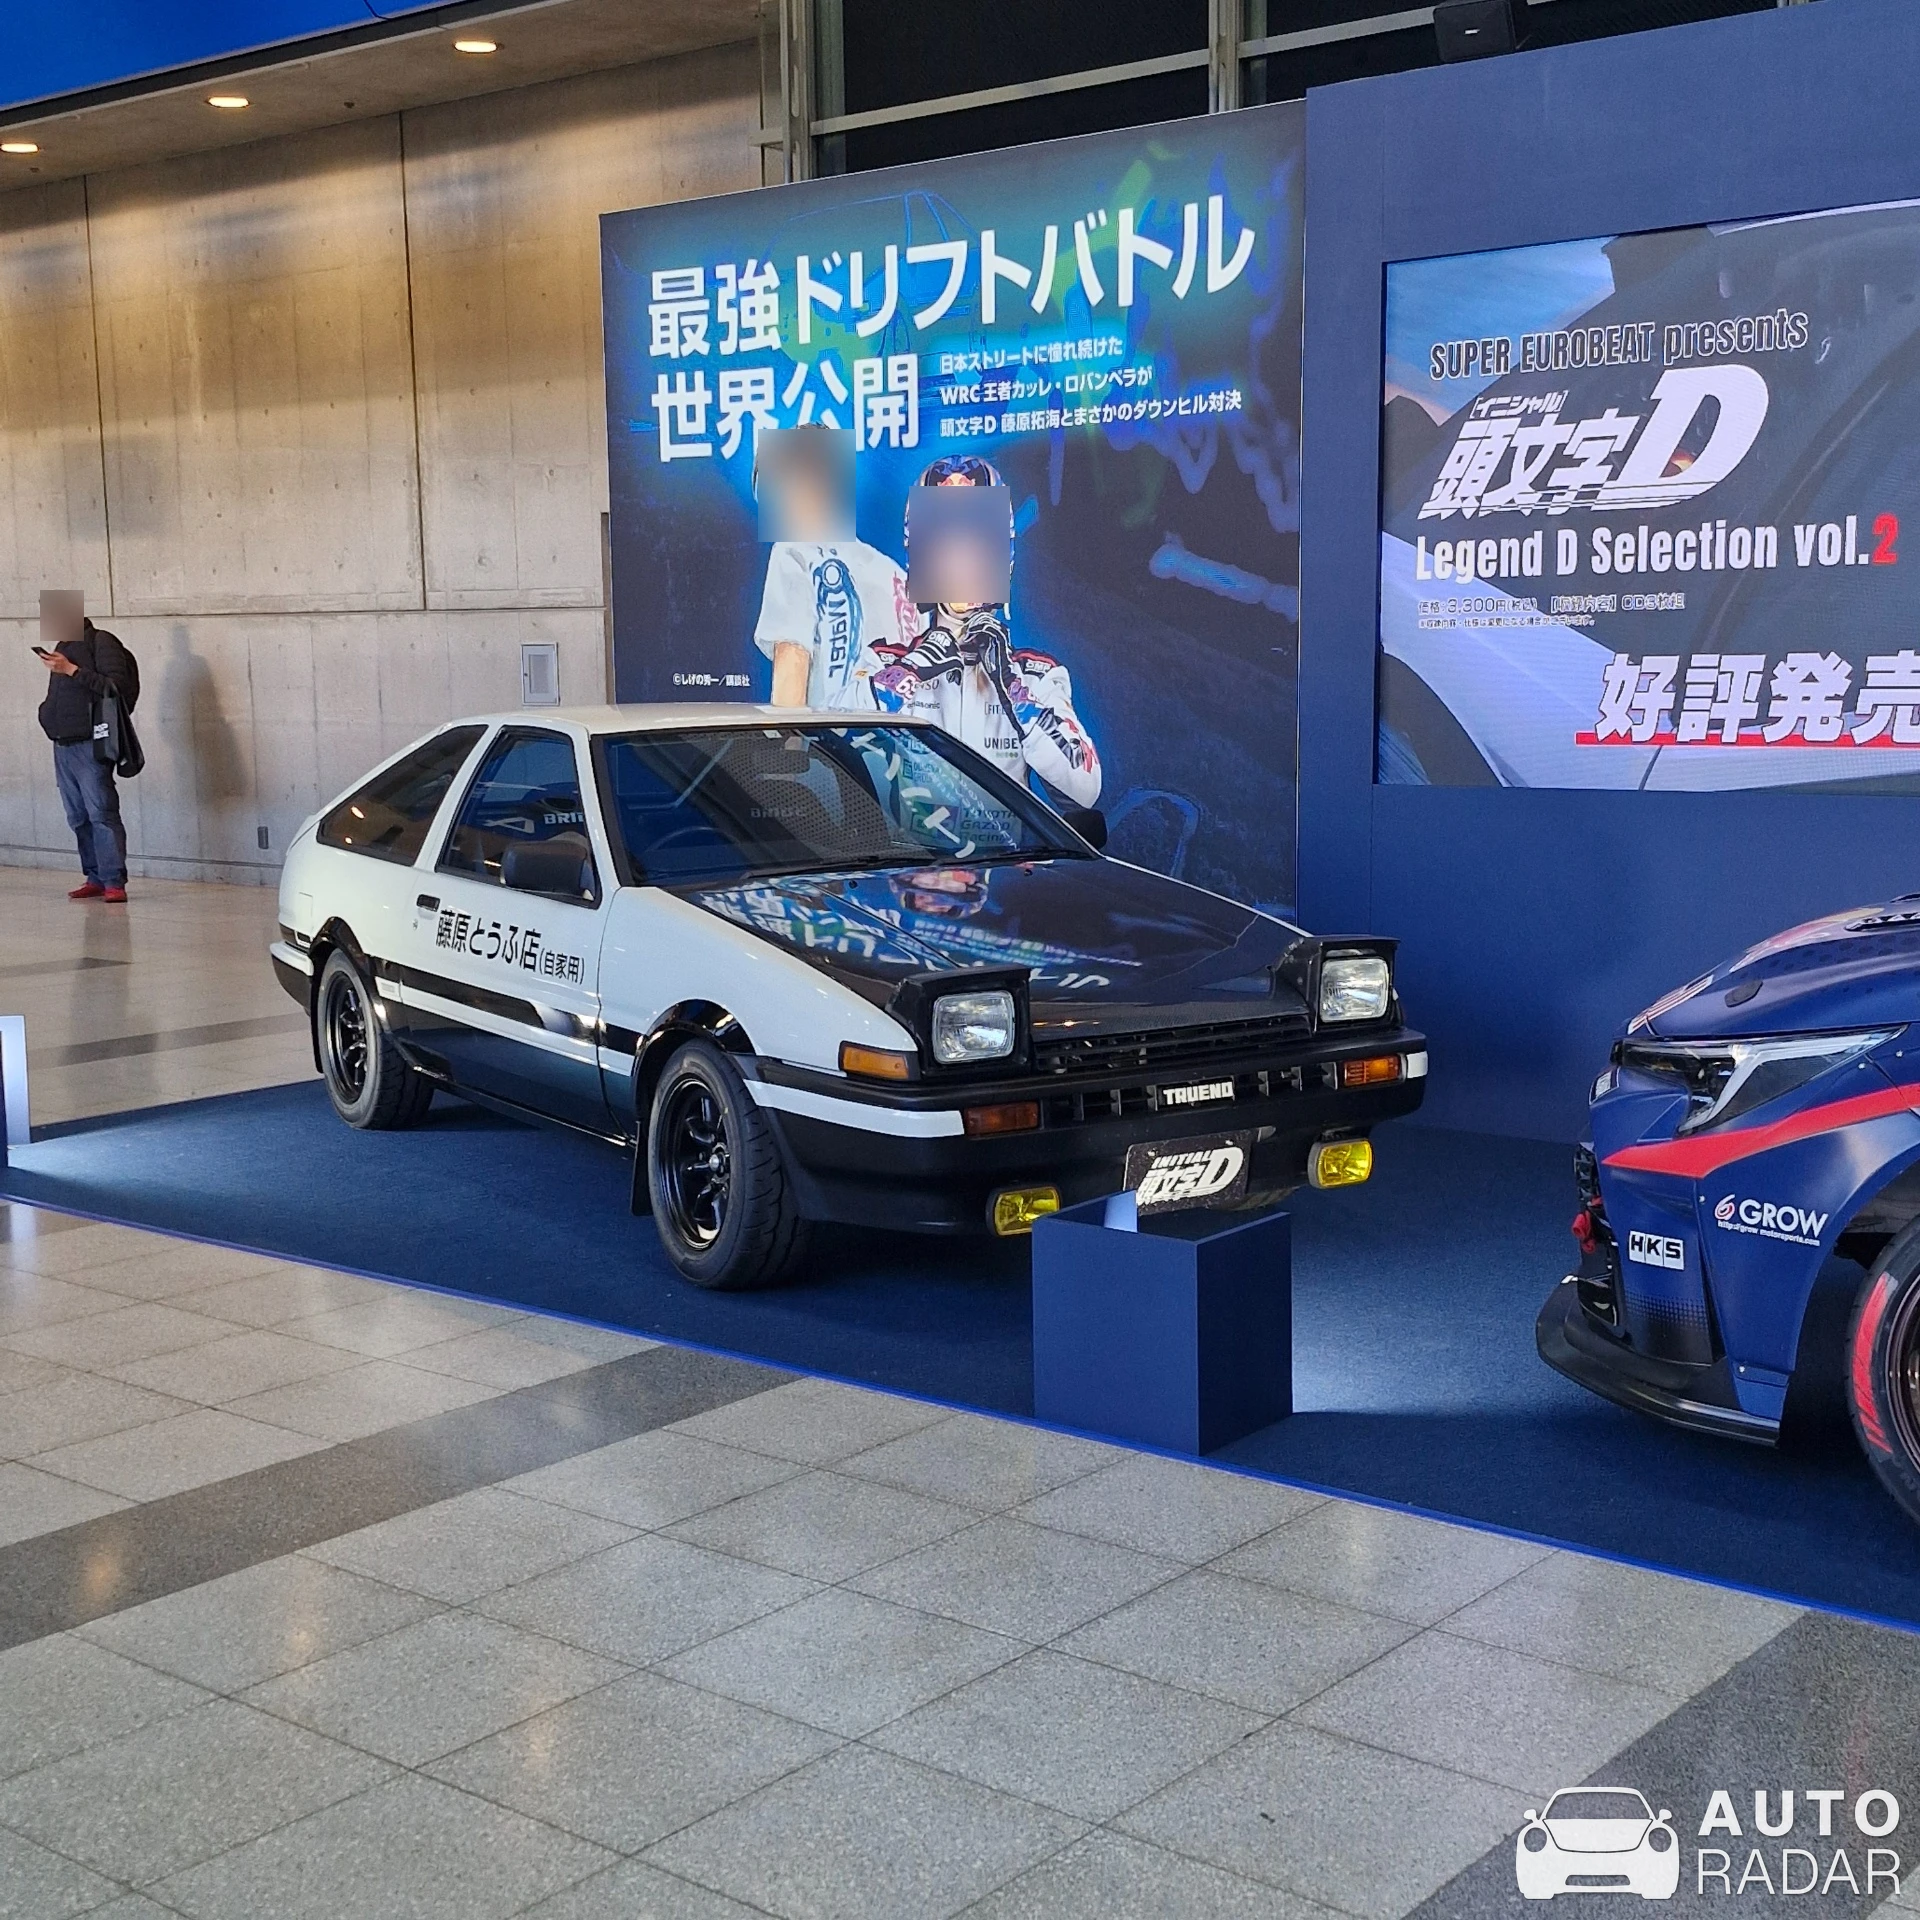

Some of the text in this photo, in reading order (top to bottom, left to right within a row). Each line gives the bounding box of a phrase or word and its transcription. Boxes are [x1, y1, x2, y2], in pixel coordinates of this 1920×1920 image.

[648, 196, 1256, 359] 最強ドリフトバトル
[940, 336, 1123, 374] 日本ストリートに憧れ続けた
[1430, 308, 1809, 380] SUPER EUROBEAT presents
[1416, 513, 1900, 585] Legend D Selection vol.2
[1594, 650, 1920, 745] 好評発売
[984, 737, 1020, 750] UNIBE
[1163, 1081, 1234, 1105] TRUENO
[1152, 1150, 1212, 1169] INITIAL
[1739, 1199, 1829, 1238] GROW
[1630, 1234, 1681, 1260] HKS
